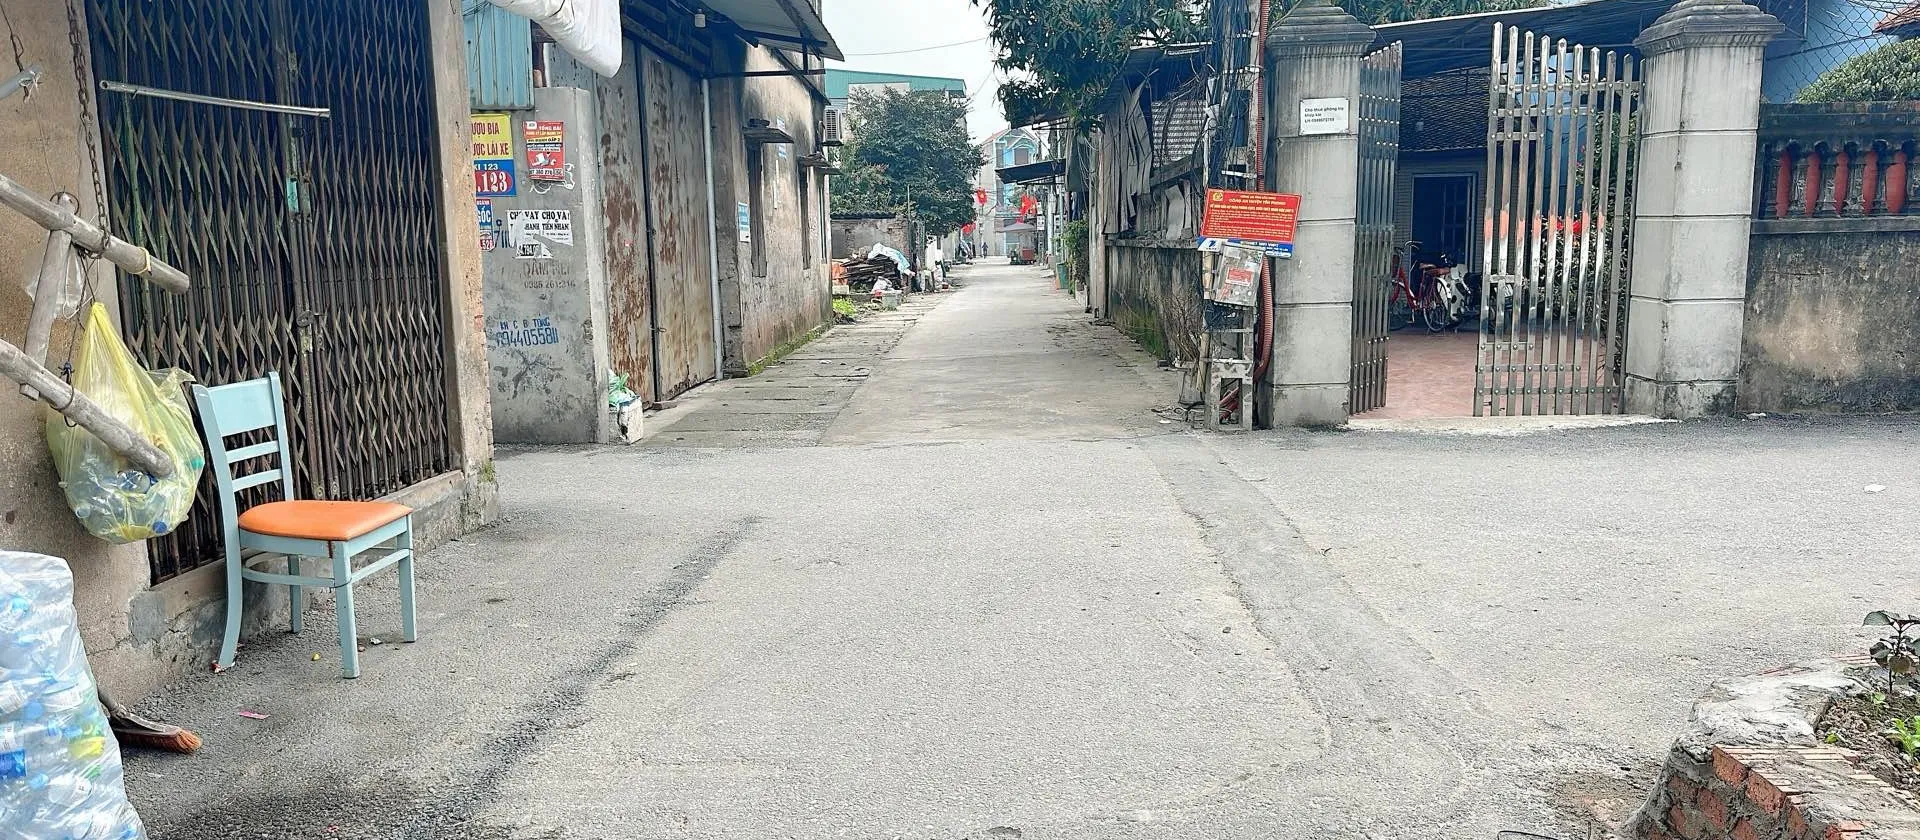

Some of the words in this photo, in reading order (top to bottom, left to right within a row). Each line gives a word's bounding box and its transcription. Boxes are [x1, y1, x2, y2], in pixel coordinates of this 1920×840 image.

[487, 122, 500, 135] BIA
[487, 140, 499, 156] LÁI
[500, 143, 510, 156] XE
[484, 163, 498, 171] 123
[513, 320, 518, 329] C
[523, 319, 529, 328] B
